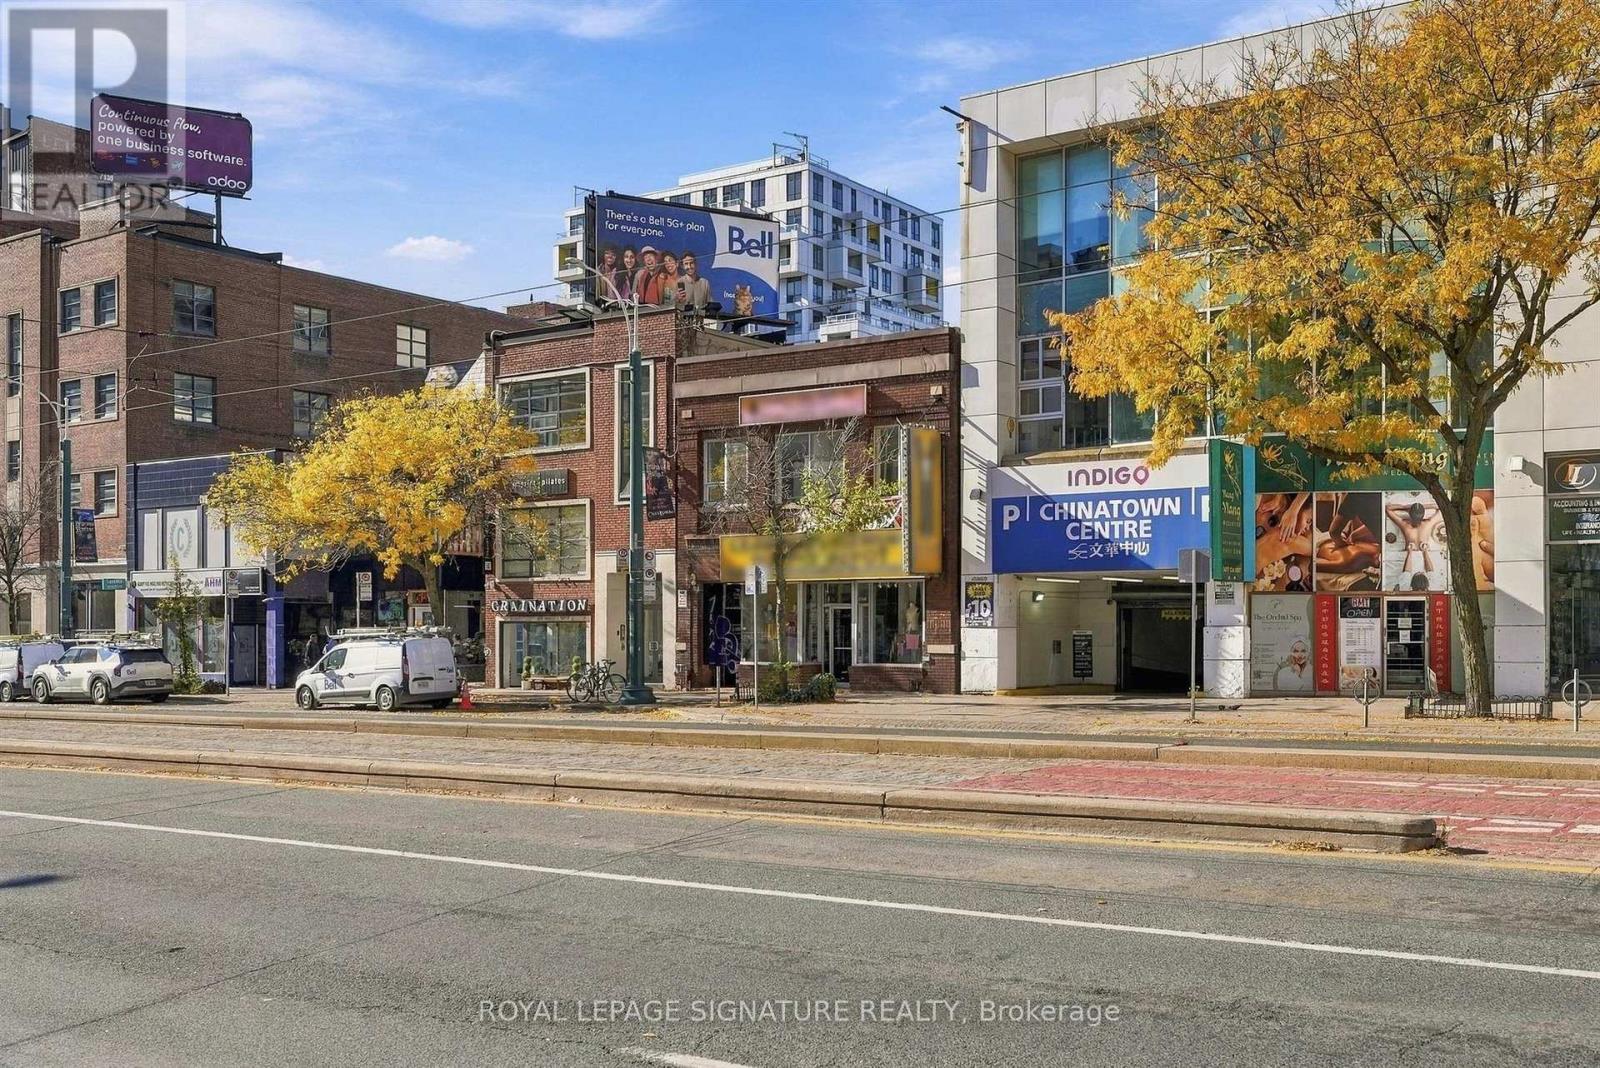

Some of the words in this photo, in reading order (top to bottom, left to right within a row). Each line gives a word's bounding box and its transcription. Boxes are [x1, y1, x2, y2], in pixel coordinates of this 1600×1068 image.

[98, 104, 170, 127] Continuous
[173, 117, 202, 134] flow,
[98, 121, 156, 138] powered
[160, 130, 175, 143] by
[97, 135, 122, 146] one
[126, 138, 184, 156] business
[187, 149, 247, 167] software.
[207, 175, 247, 190] odoo
[605, 209, 638, 222] There's
[649, 215, 665, 226] Bell
[667, 218, 684, 228] 5G+
[686, 222, 705, 232] plan
[605, 221, 619, 230] for
[621, 225, 665, 237] everyone.
[728, 226, 773, 259] Bell
[541, 478, 566, 486] pilates
[1067, 465, 1150, 487] INDIGO
[1003, 504, 1020, 530] P
[1039, 497, 1180, 521] CHINATOWN
[1066, 519, 1152, 540] CENTRE
[491, 599, 587, 612] GRAINATION
[324, 679, 337, 690] Bell
